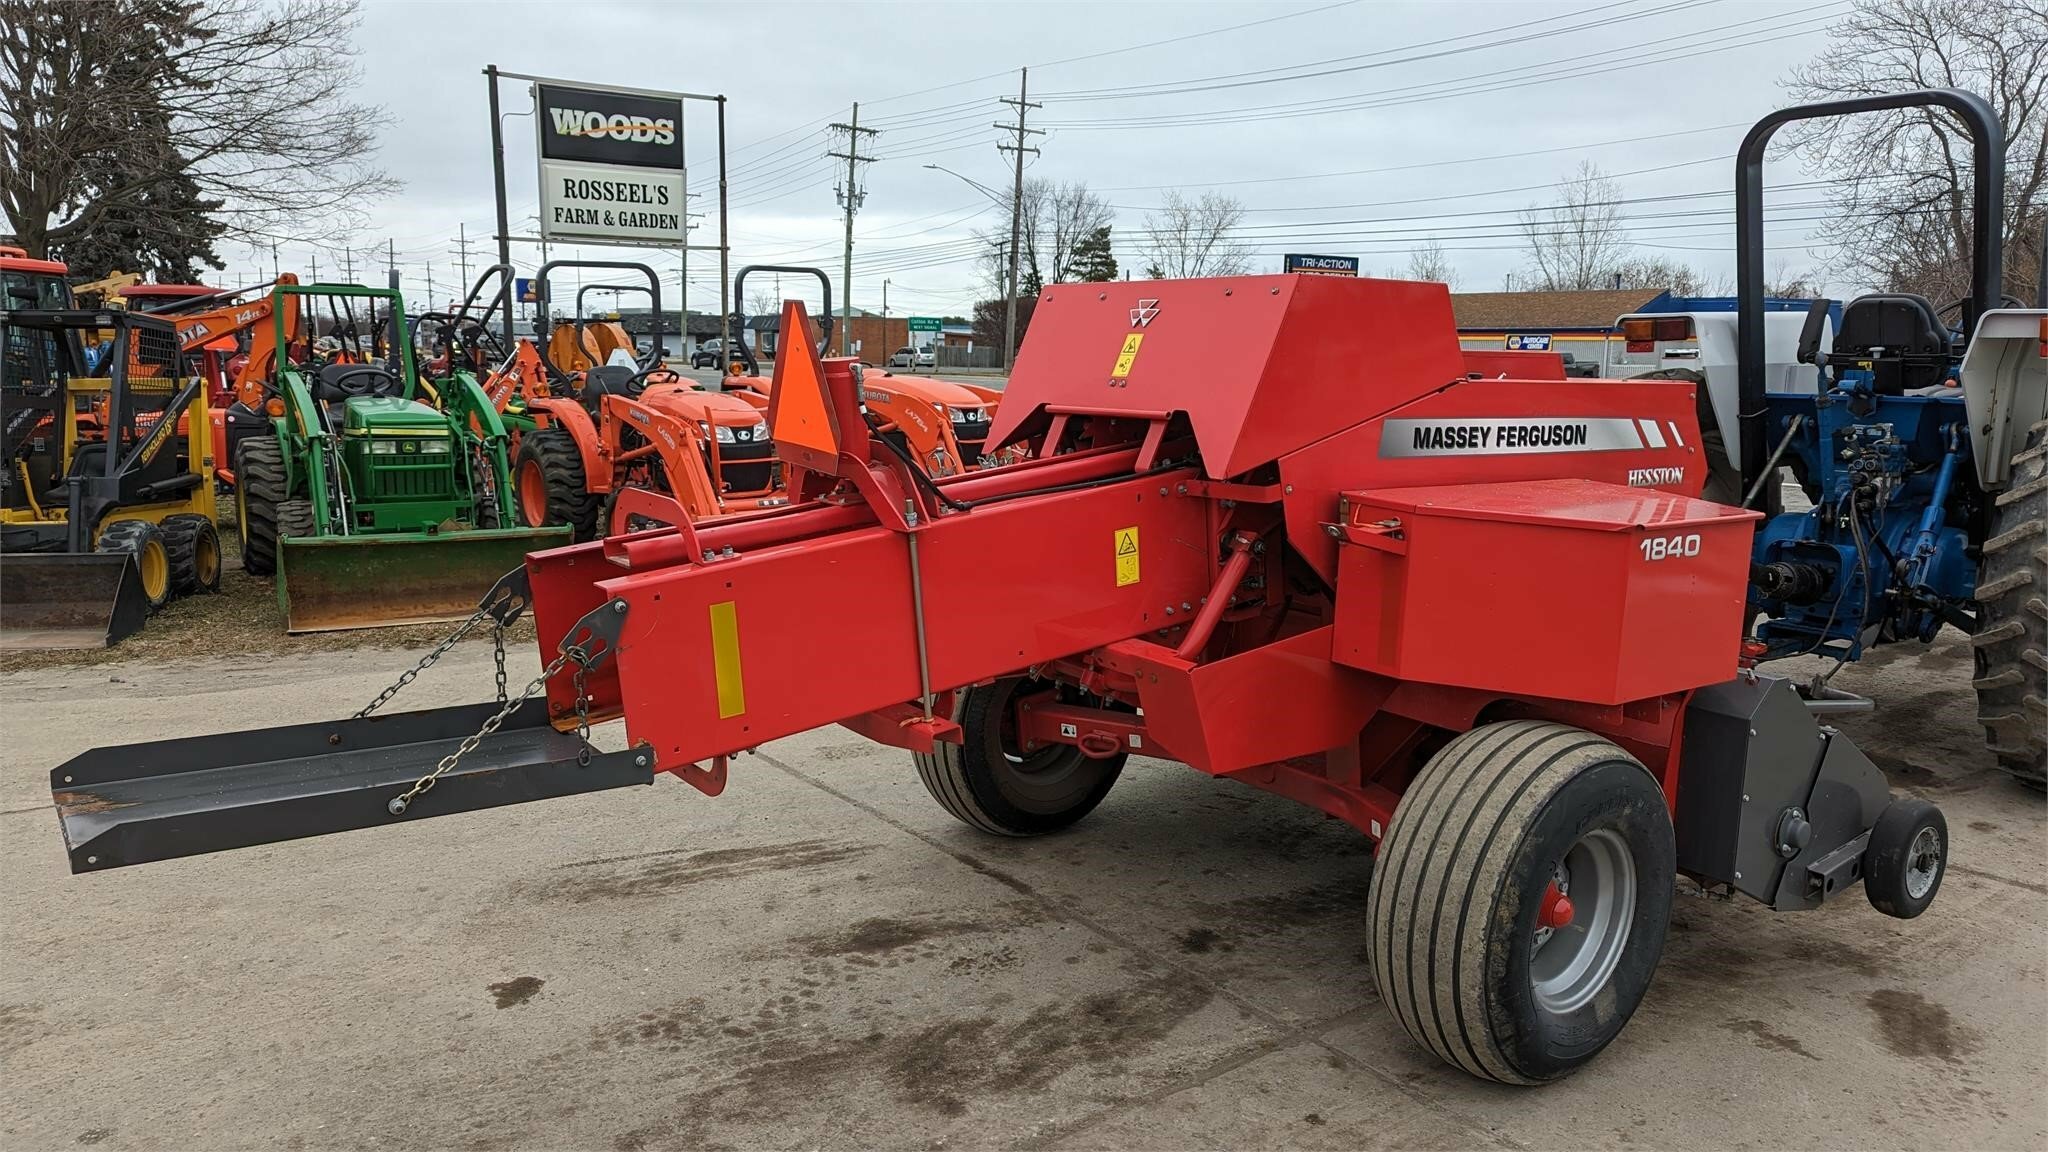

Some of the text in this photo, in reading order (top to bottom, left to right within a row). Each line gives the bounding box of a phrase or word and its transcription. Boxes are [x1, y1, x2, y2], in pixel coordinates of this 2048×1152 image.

[549, 107, 675, 146] WOODS
[563, 178, 669, 205] ROSSEEL'S
[554, 207, 678, 230] FARM & GARDEN
[1413, 424, 1587, 450] MASSEY FERGUSON
[1628, 467, 1684, 487] HESSTON
[1640, 534, 1700, 561] 1840
